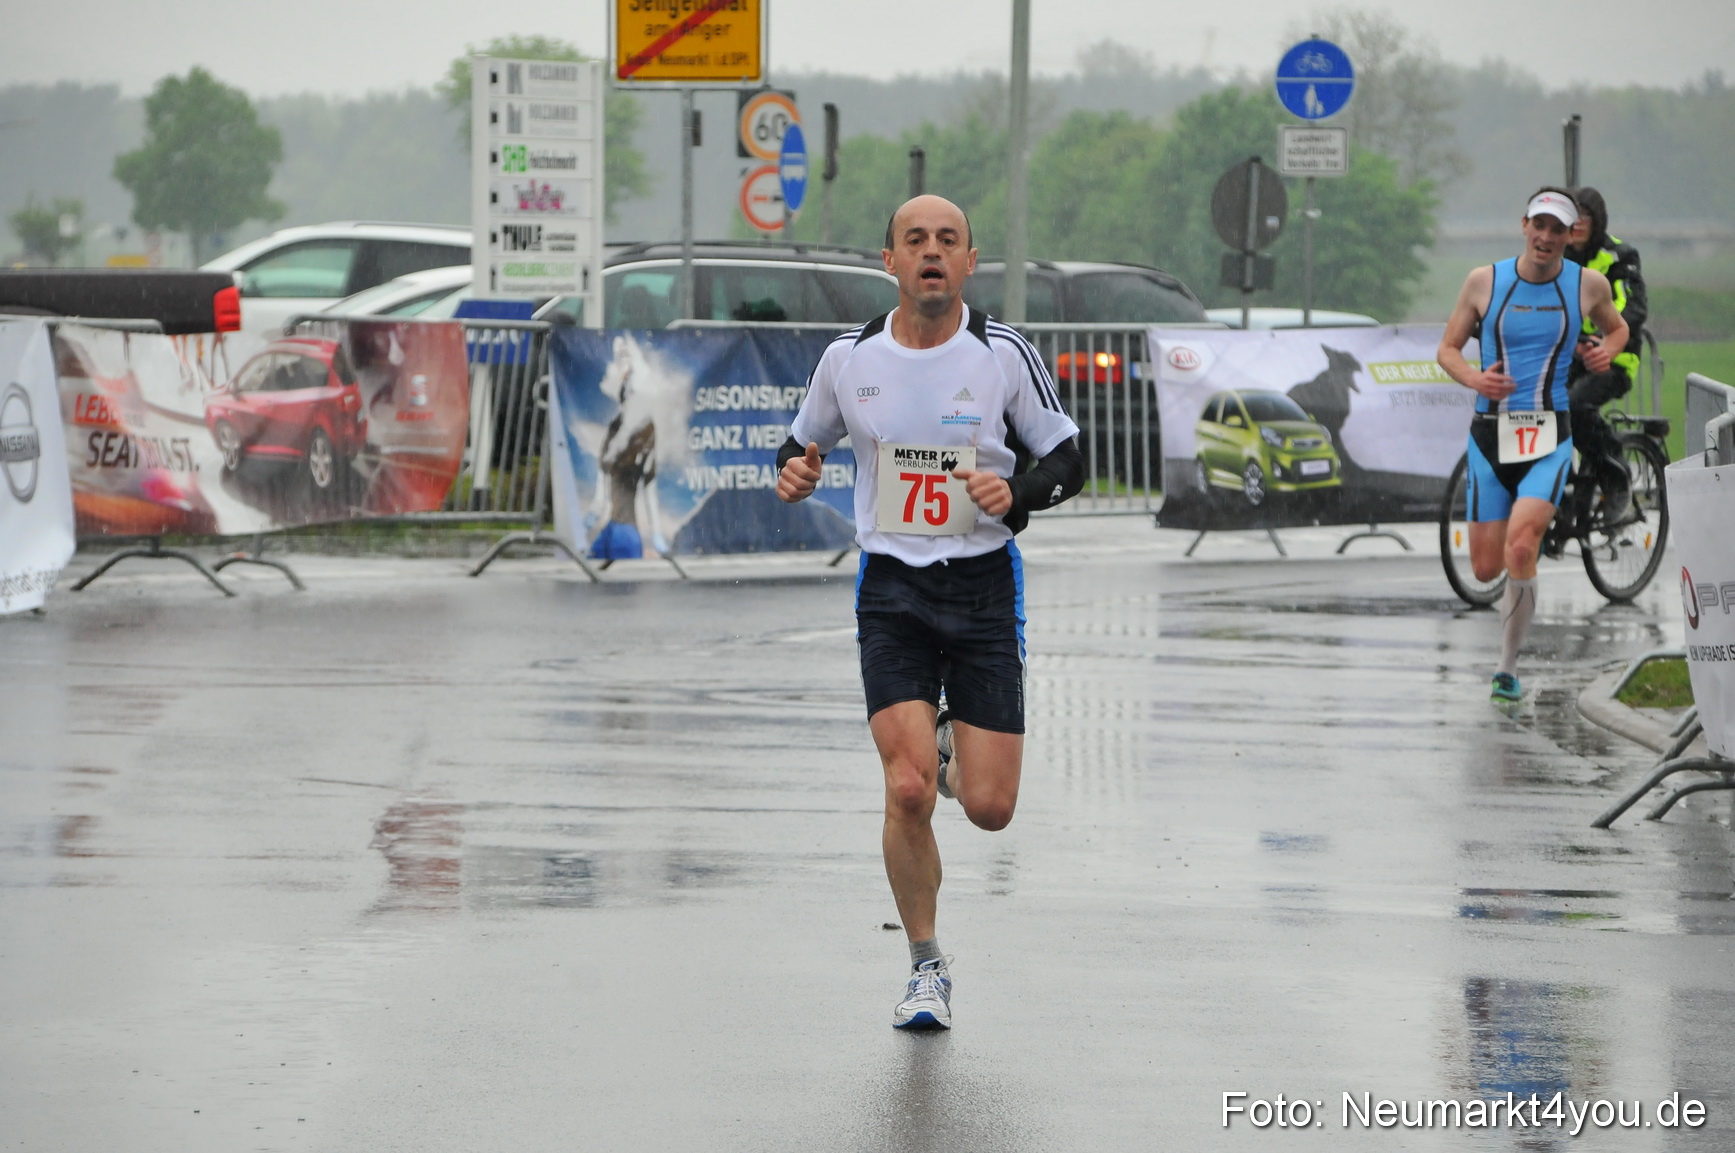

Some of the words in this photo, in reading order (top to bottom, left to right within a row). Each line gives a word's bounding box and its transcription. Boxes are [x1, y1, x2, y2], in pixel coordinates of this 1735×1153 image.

[680, 21, 731, 40] Anger
[658, 54, 709, 65] Neumarkt
[1375, 365, 1401, 381] DER
[1402, 364, 1434, 380] NEUE
[689, 424, 743, 449] GANZ
[1515, 427, 1539, 455] 17
[894, 448, 938, 460] MEYER
[894, 459, 938, 469] WERBUNG
[900, 472, 949, 526] 75
